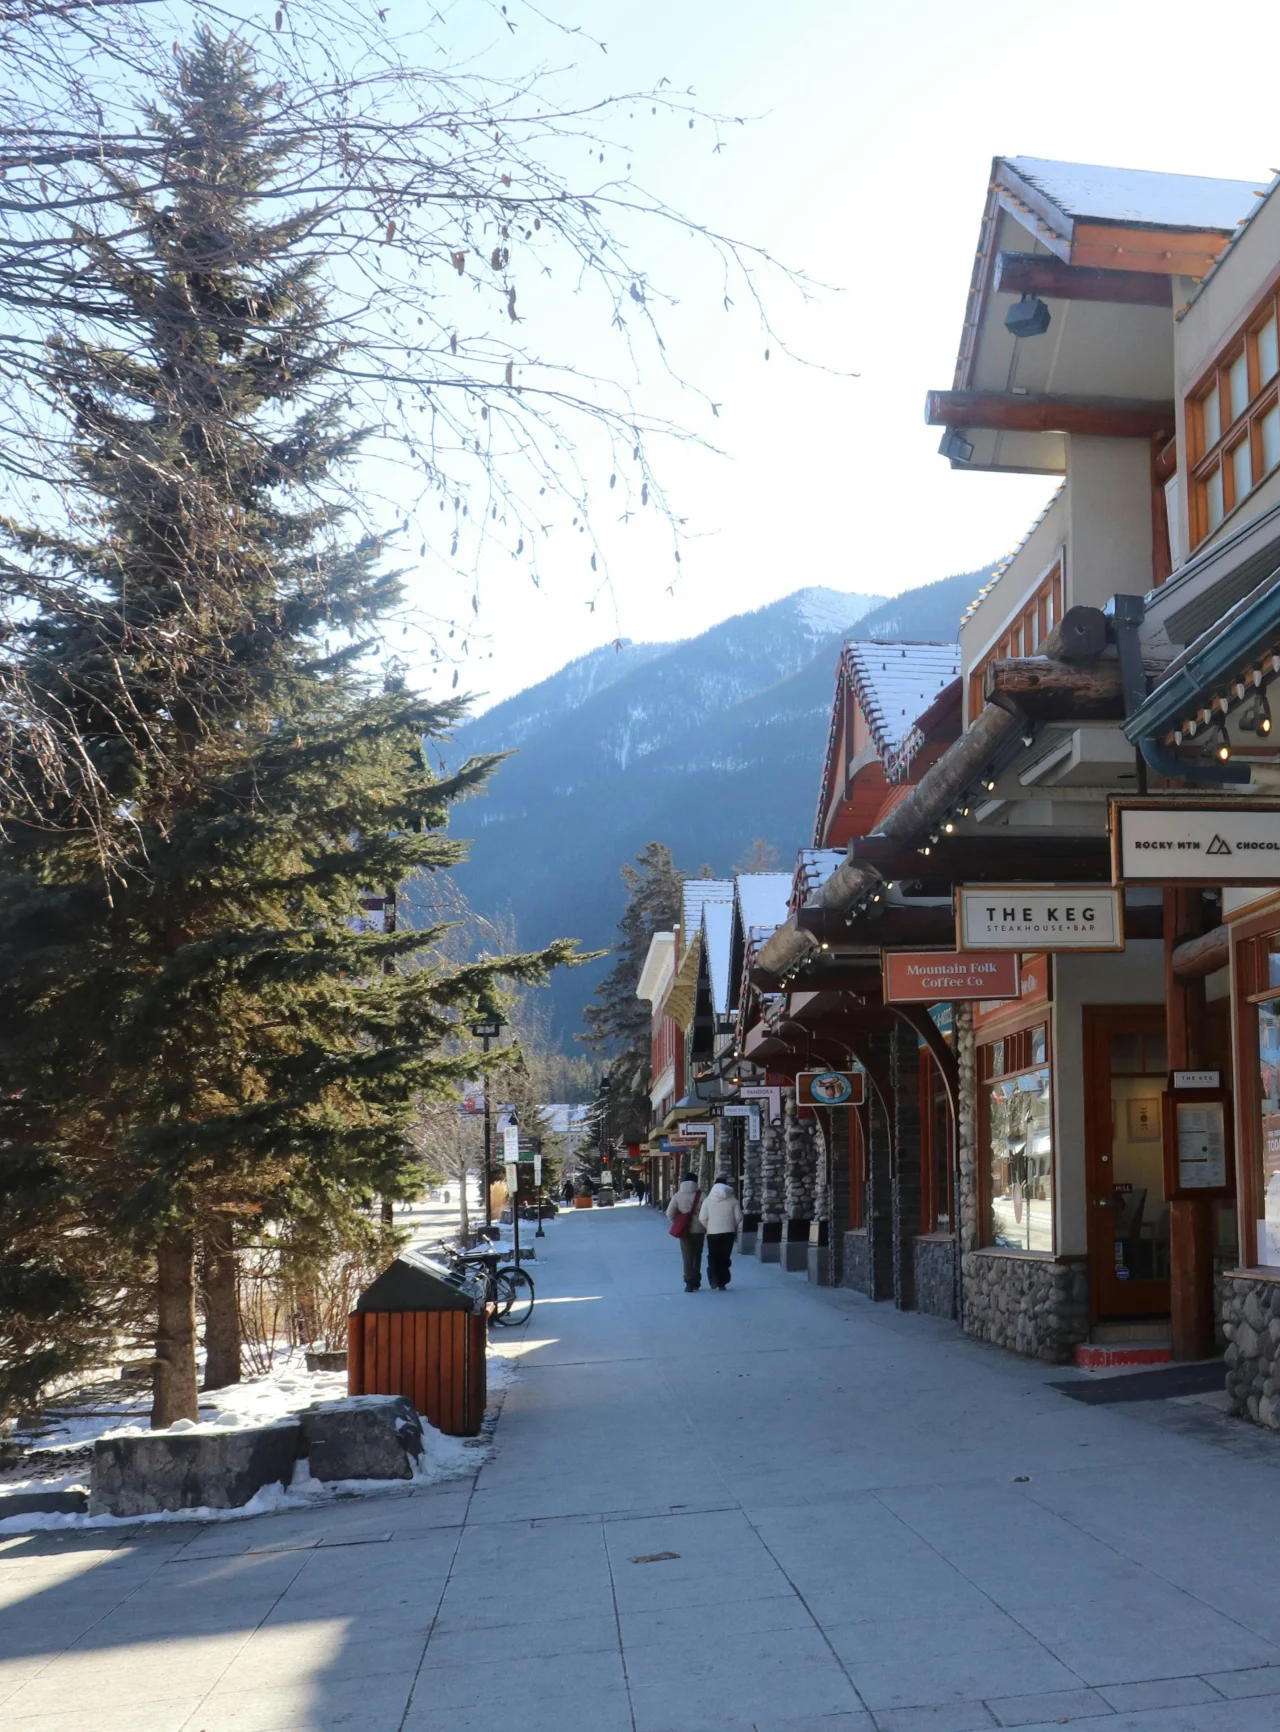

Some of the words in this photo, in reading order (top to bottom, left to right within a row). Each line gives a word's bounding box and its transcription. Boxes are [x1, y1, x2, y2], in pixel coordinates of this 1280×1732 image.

[1135, 841, 1173, 850] ROCKY
[1177, 841, 1200, 850] MTN
[986, 908, 1033, 921] THE
[1048, 908, 1096, 921] KEG
[907, 963, 967, 975] Mountain
[970, 962, 998, 973] Folk
[921, 977, 964, 988] Coffee
[967, 977, 985, 987] Co.
